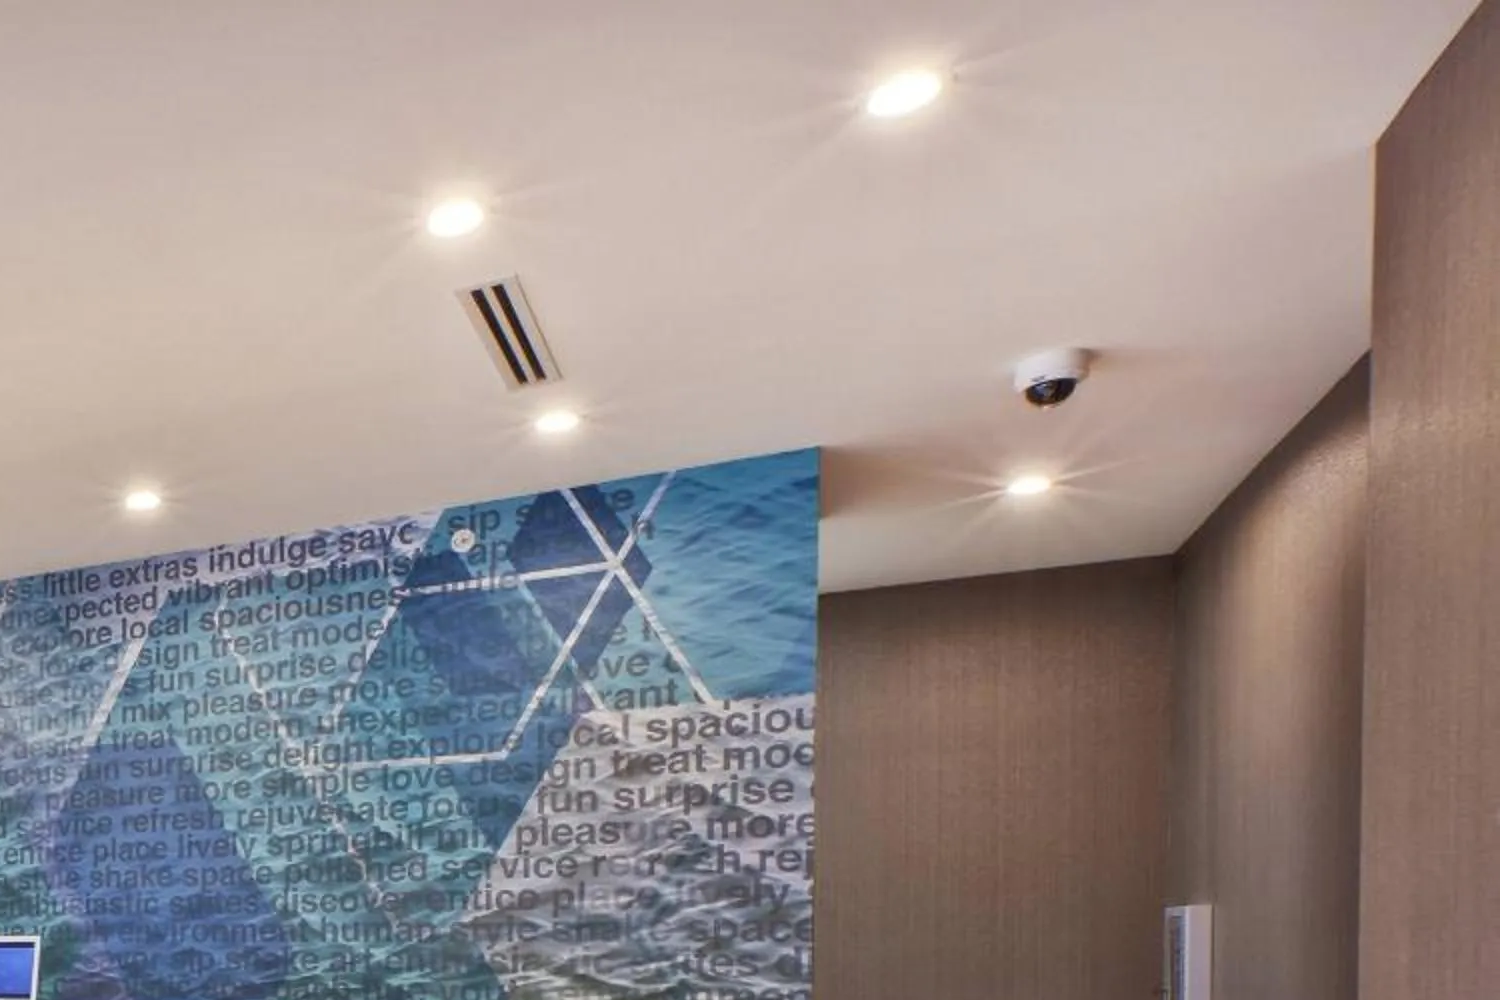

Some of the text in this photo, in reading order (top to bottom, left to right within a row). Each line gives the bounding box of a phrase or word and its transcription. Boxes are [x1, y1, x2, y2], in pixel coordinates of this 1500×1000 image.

[42, 568, 100, 597] little
[108, 556, 198, 587] extras
[207, 536, 327, 572] indulge
[337, 521, 420, 552] savo
[446, 505, 503, 538] sip
[0, 585, 158, 630] unexpected
[167, 570, 275, 607] vibrant
[284, 544, 455, 594] optimist
[12, 624, 112, 655] explore
[120, 607, 190, 639] local
[103, 638, 200, 668] dsign
[209, 626, 279, 656] treat
[147, 667, 196, 691] fun
[204, 651, 337, 686] surprise
[110, 725, 175, 751] treat
[184, 715, 304, 745] modern
[314, 691, 522, 734] unexpected
[120, 696, 172, 722] mix
[181, 686, 317, 723] pleasure
[327, 677, 416, 703] more
[128, 746, 252, 779] surprise
[261, 734, 375, 769] delight
[386, 726, 523, 762] explore
[534, 713, 631, 747] local
[173, 779, 251, 801] more
[260, 766, 370, 799] simple
[380, 763, 456, 789] love
[466, 752, 598, 786] design
[610, 744, 707, 775] treat
[15, 811, 113, 837] service
[121, 803, 226, 832] refresh
[235, 796, 409, 832] rejuvenate
[535, 785, 600, 813] fun
[612, 775, 792, 813] surprise
[89, 862, 174, 887] shake
[182, 865, 274, 891] space
[441, 851, 578, 879] service
[91, 837, 167, 867] place
[176, 832, 256, 862] lively
